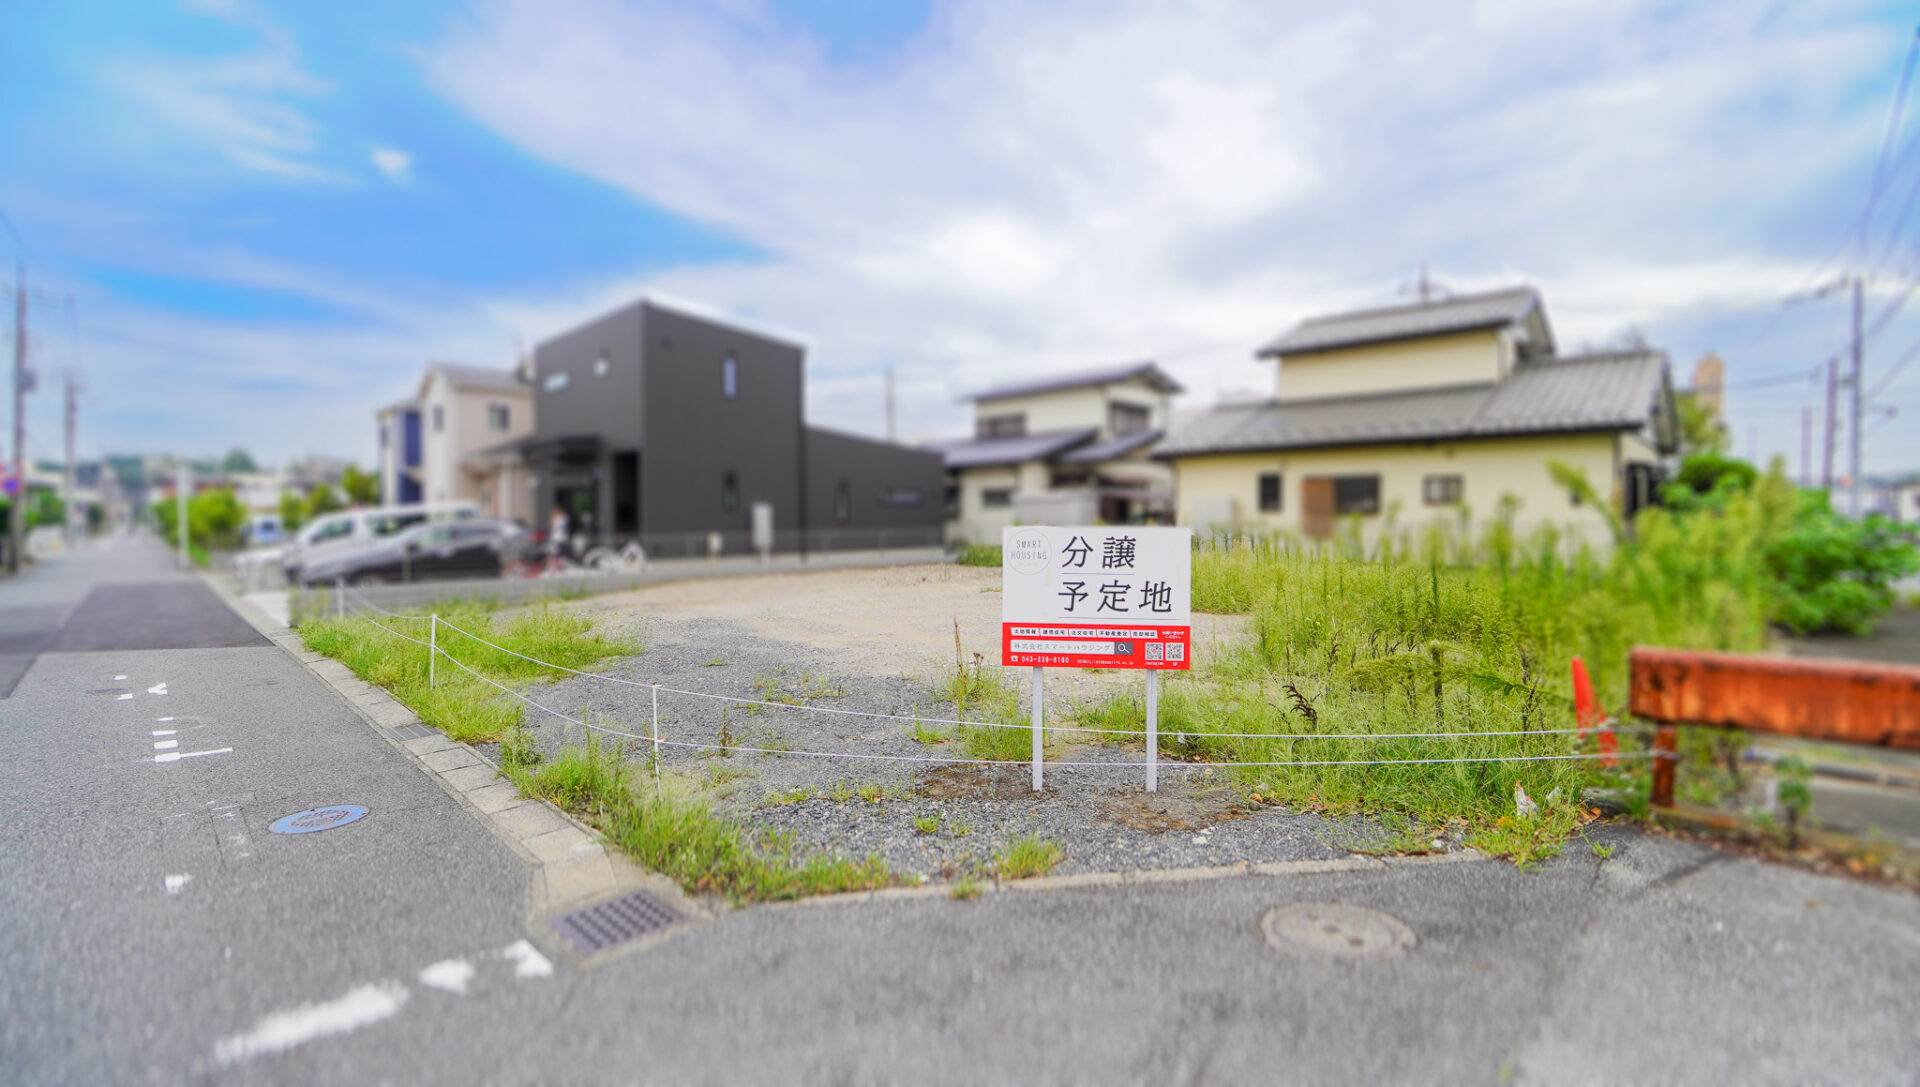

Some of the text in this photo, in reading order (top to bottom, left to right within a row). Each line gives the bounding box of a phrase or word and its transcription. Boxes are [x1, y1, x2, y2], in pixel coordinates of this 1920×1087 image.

[1010, 550, 1048, 560] HOUSING
[1016, 539, 1042, 549] SMART
[1061, 535, 1137, 569] 分譲
[1058, 579, 1173, 613] 予定地
